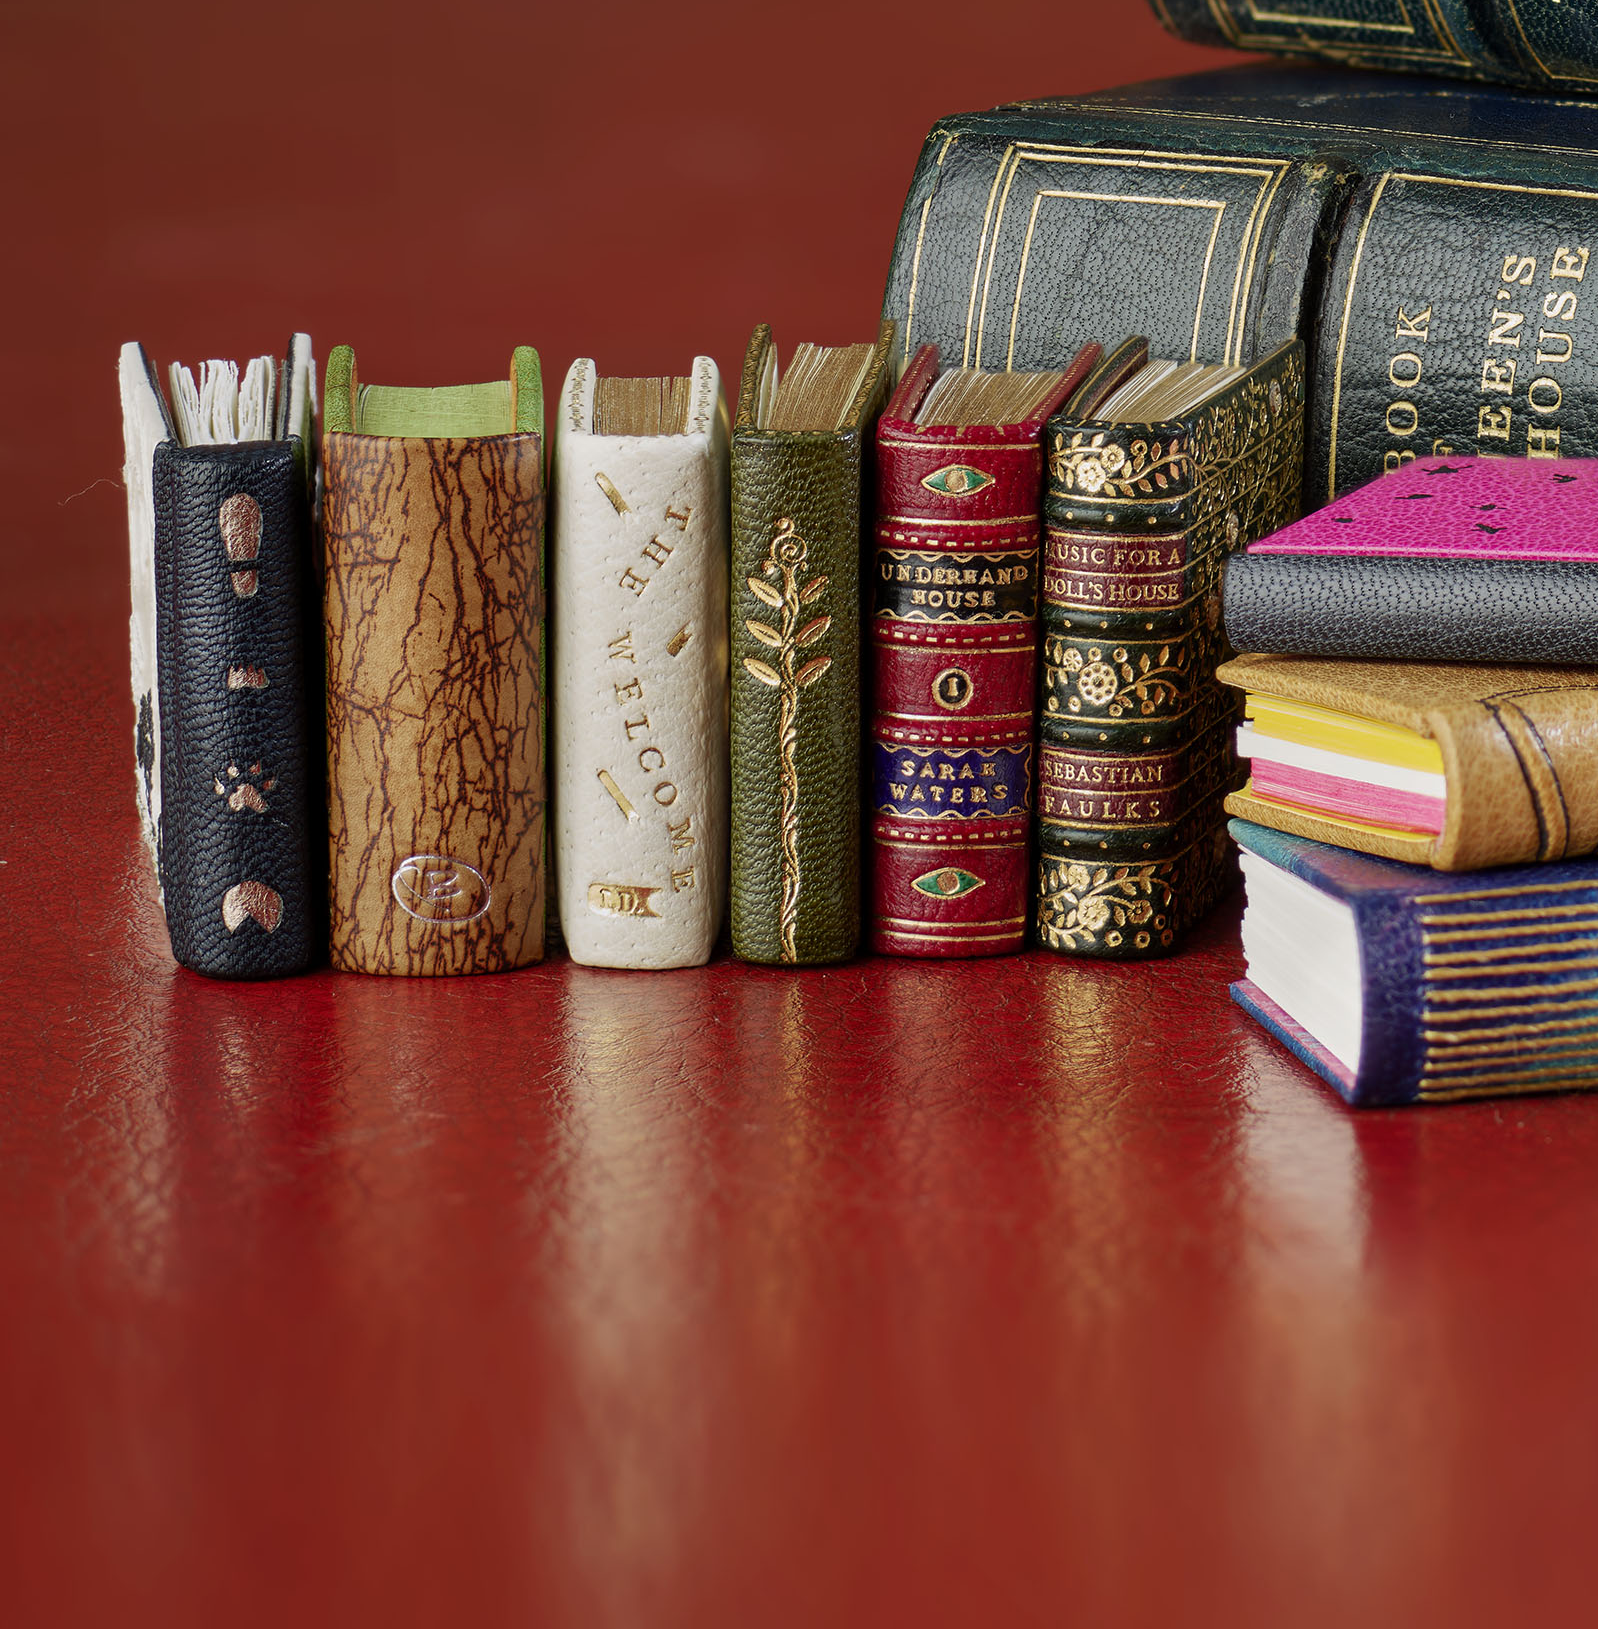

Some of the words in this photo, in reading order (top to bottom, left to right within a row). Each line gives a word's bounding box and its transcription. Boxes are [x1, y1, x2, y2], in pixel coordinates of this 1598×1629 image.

[1477, 255, 1537, 458] EEN'S
[1527, 246, 1591, 460] HOUSE
[618, 503, 694, 598] THE
[1113, 548, 1162, 566] FOR
[1167, 547, 1181, 565] A
[910, 589, 996, 608] HOUSE
[1108, 583, 1180, 602] HOUSE
[607, 631, 697, 894] WELCOME
[901, 759, 997, 781] SARAH
[1045, 759, 1163, 784] SEBASTIAN
[888, 782, 1009, 804] WATERS
[1045, 795, 1161, 818] FAULKS
